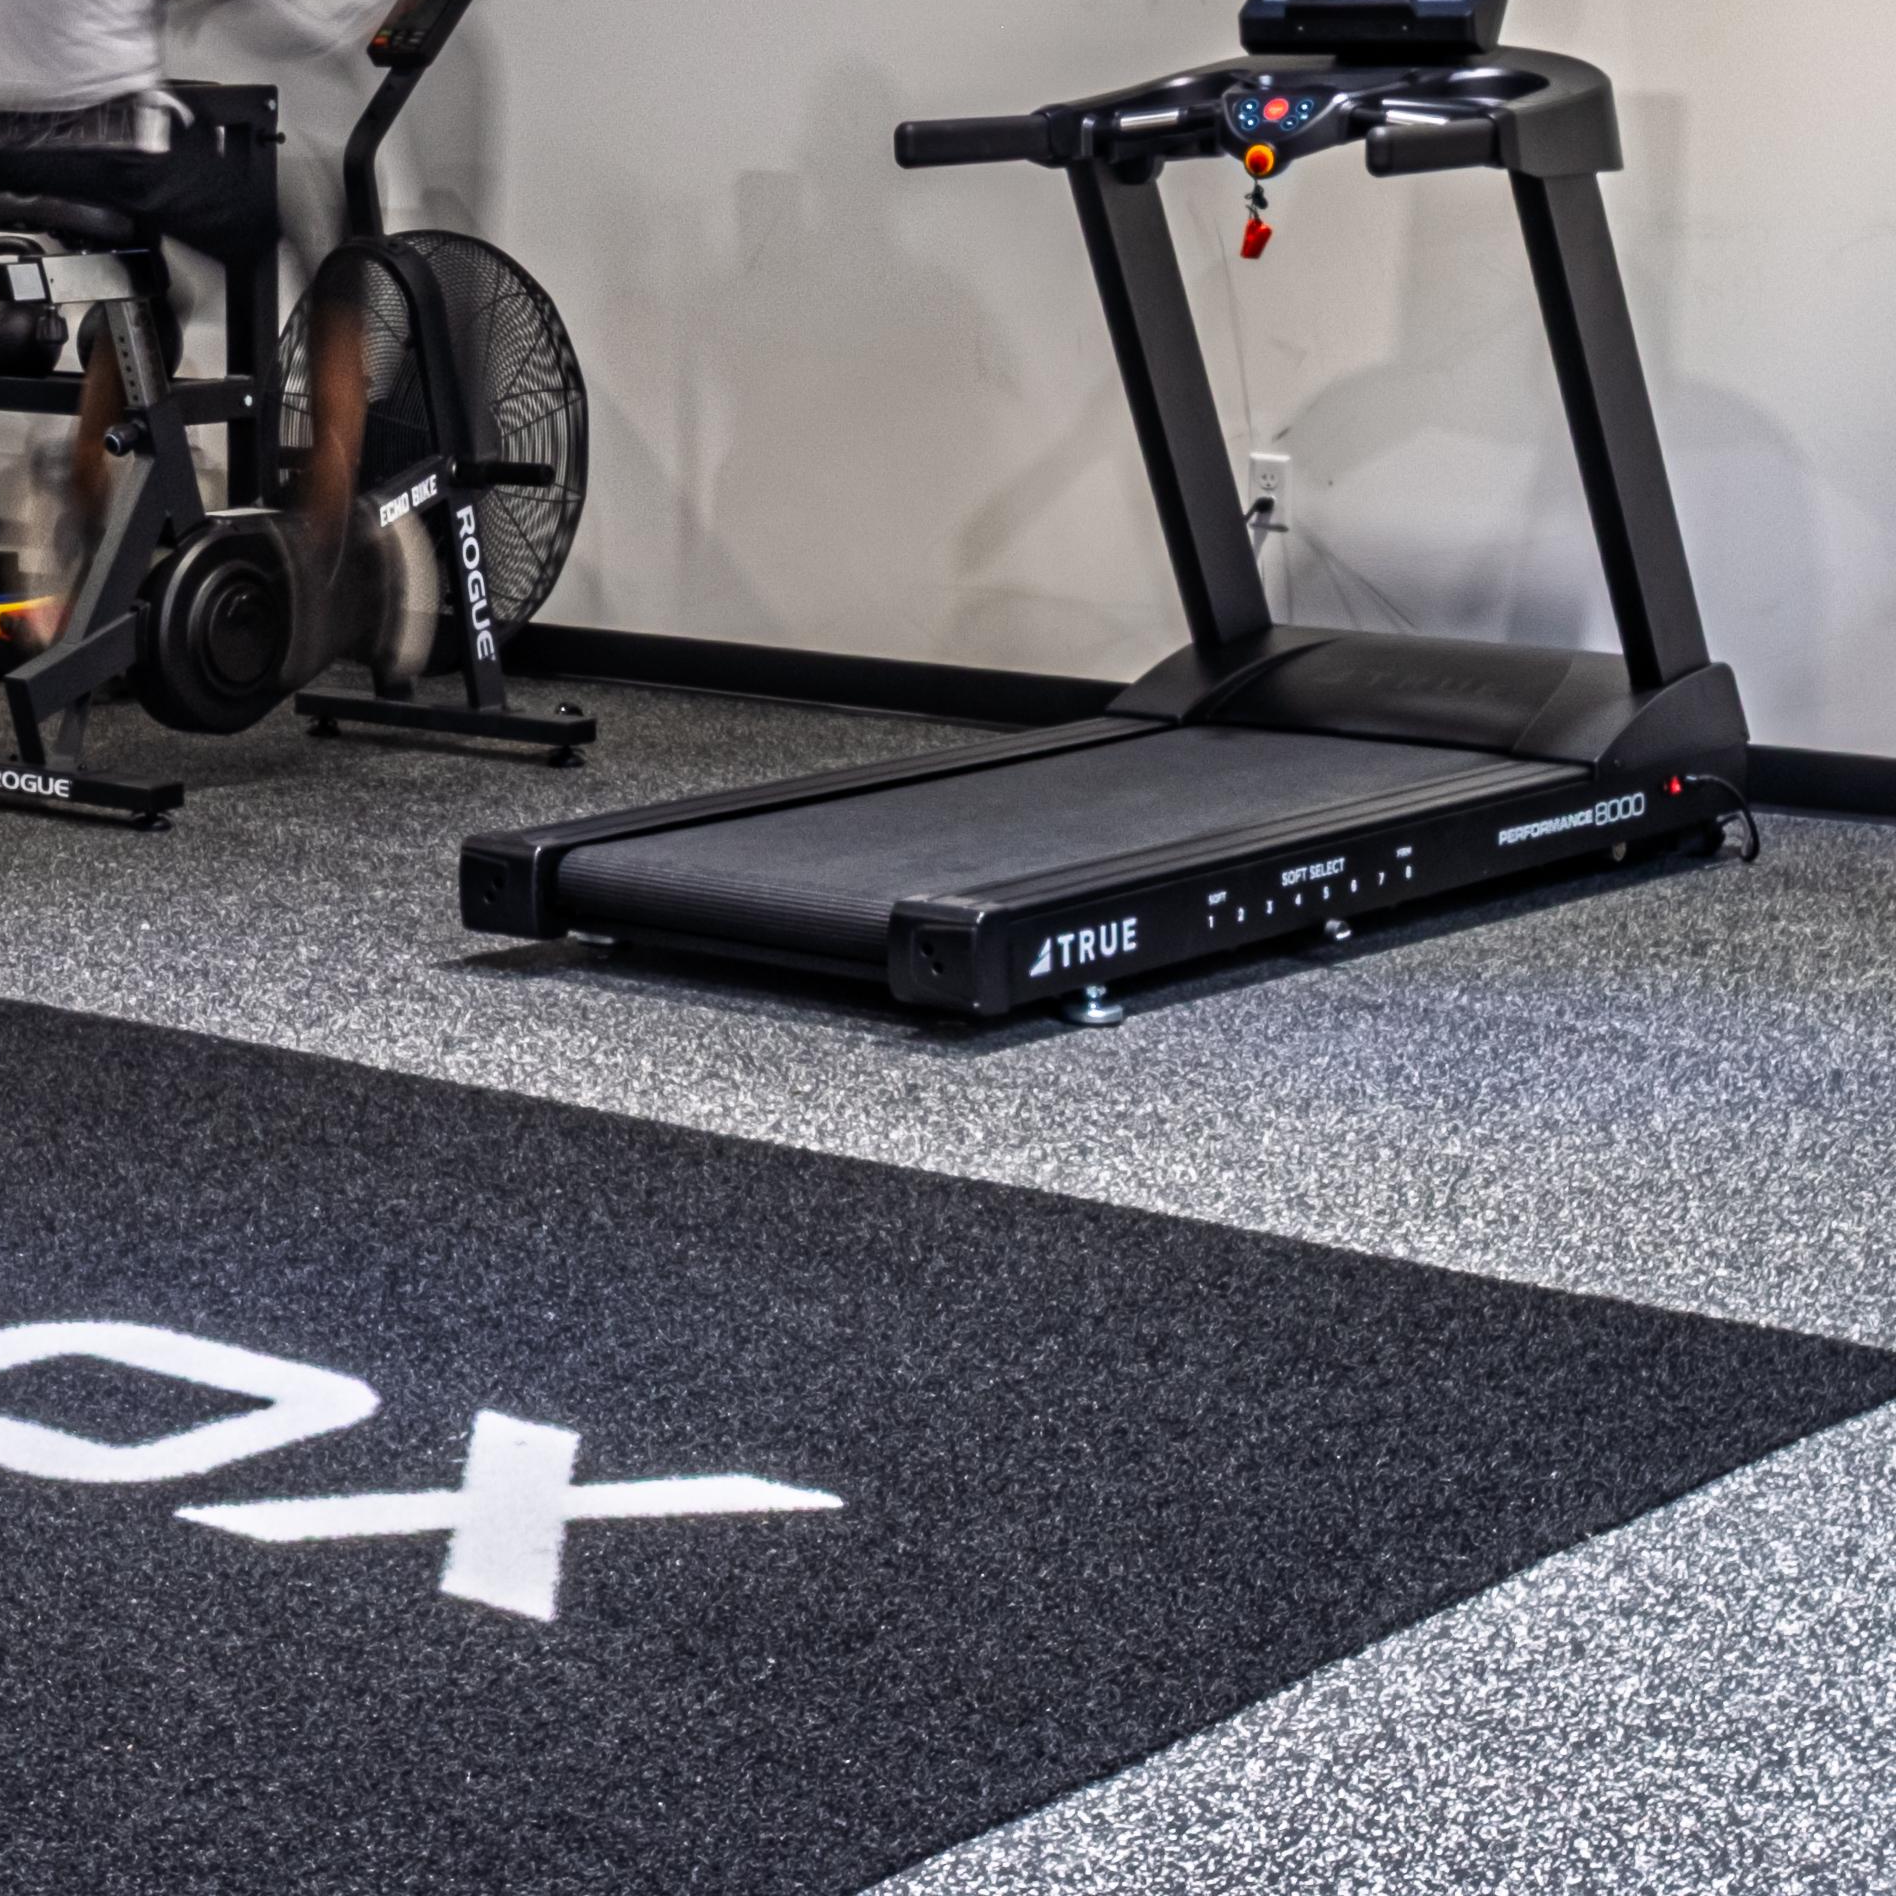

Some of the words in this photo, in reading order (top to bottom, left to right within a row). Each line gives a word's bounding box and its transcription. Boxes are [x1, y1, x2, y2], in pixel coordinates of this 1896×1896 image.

[379, 492, 410, 528] ECHO
[411, 474, 438, 507] BIKE
[456, 505, 494, 661] ROGUE
[1498, 809, 1594, 846] PERFORMANCE
[1595, 791, 1646, 826] 8000
[1208, 914, 1215, 929] 1
[1237, 906, 1245, 923] 2
[1294, 892, 1302, 907] 4
[1322, 885, 1330, 901] 5
[1350, 878, 1358, 893] 6
[1378, 871, 1386, 886] 7
[1405, 864, 1413, 880] 8
[1208, 891, 1228, 905] SOFT
[1281, 867, 1308, 887] SOFT
[1309, 857, 1346, 880] SELECT
[1056, 917, 1139, 968] TRUE
